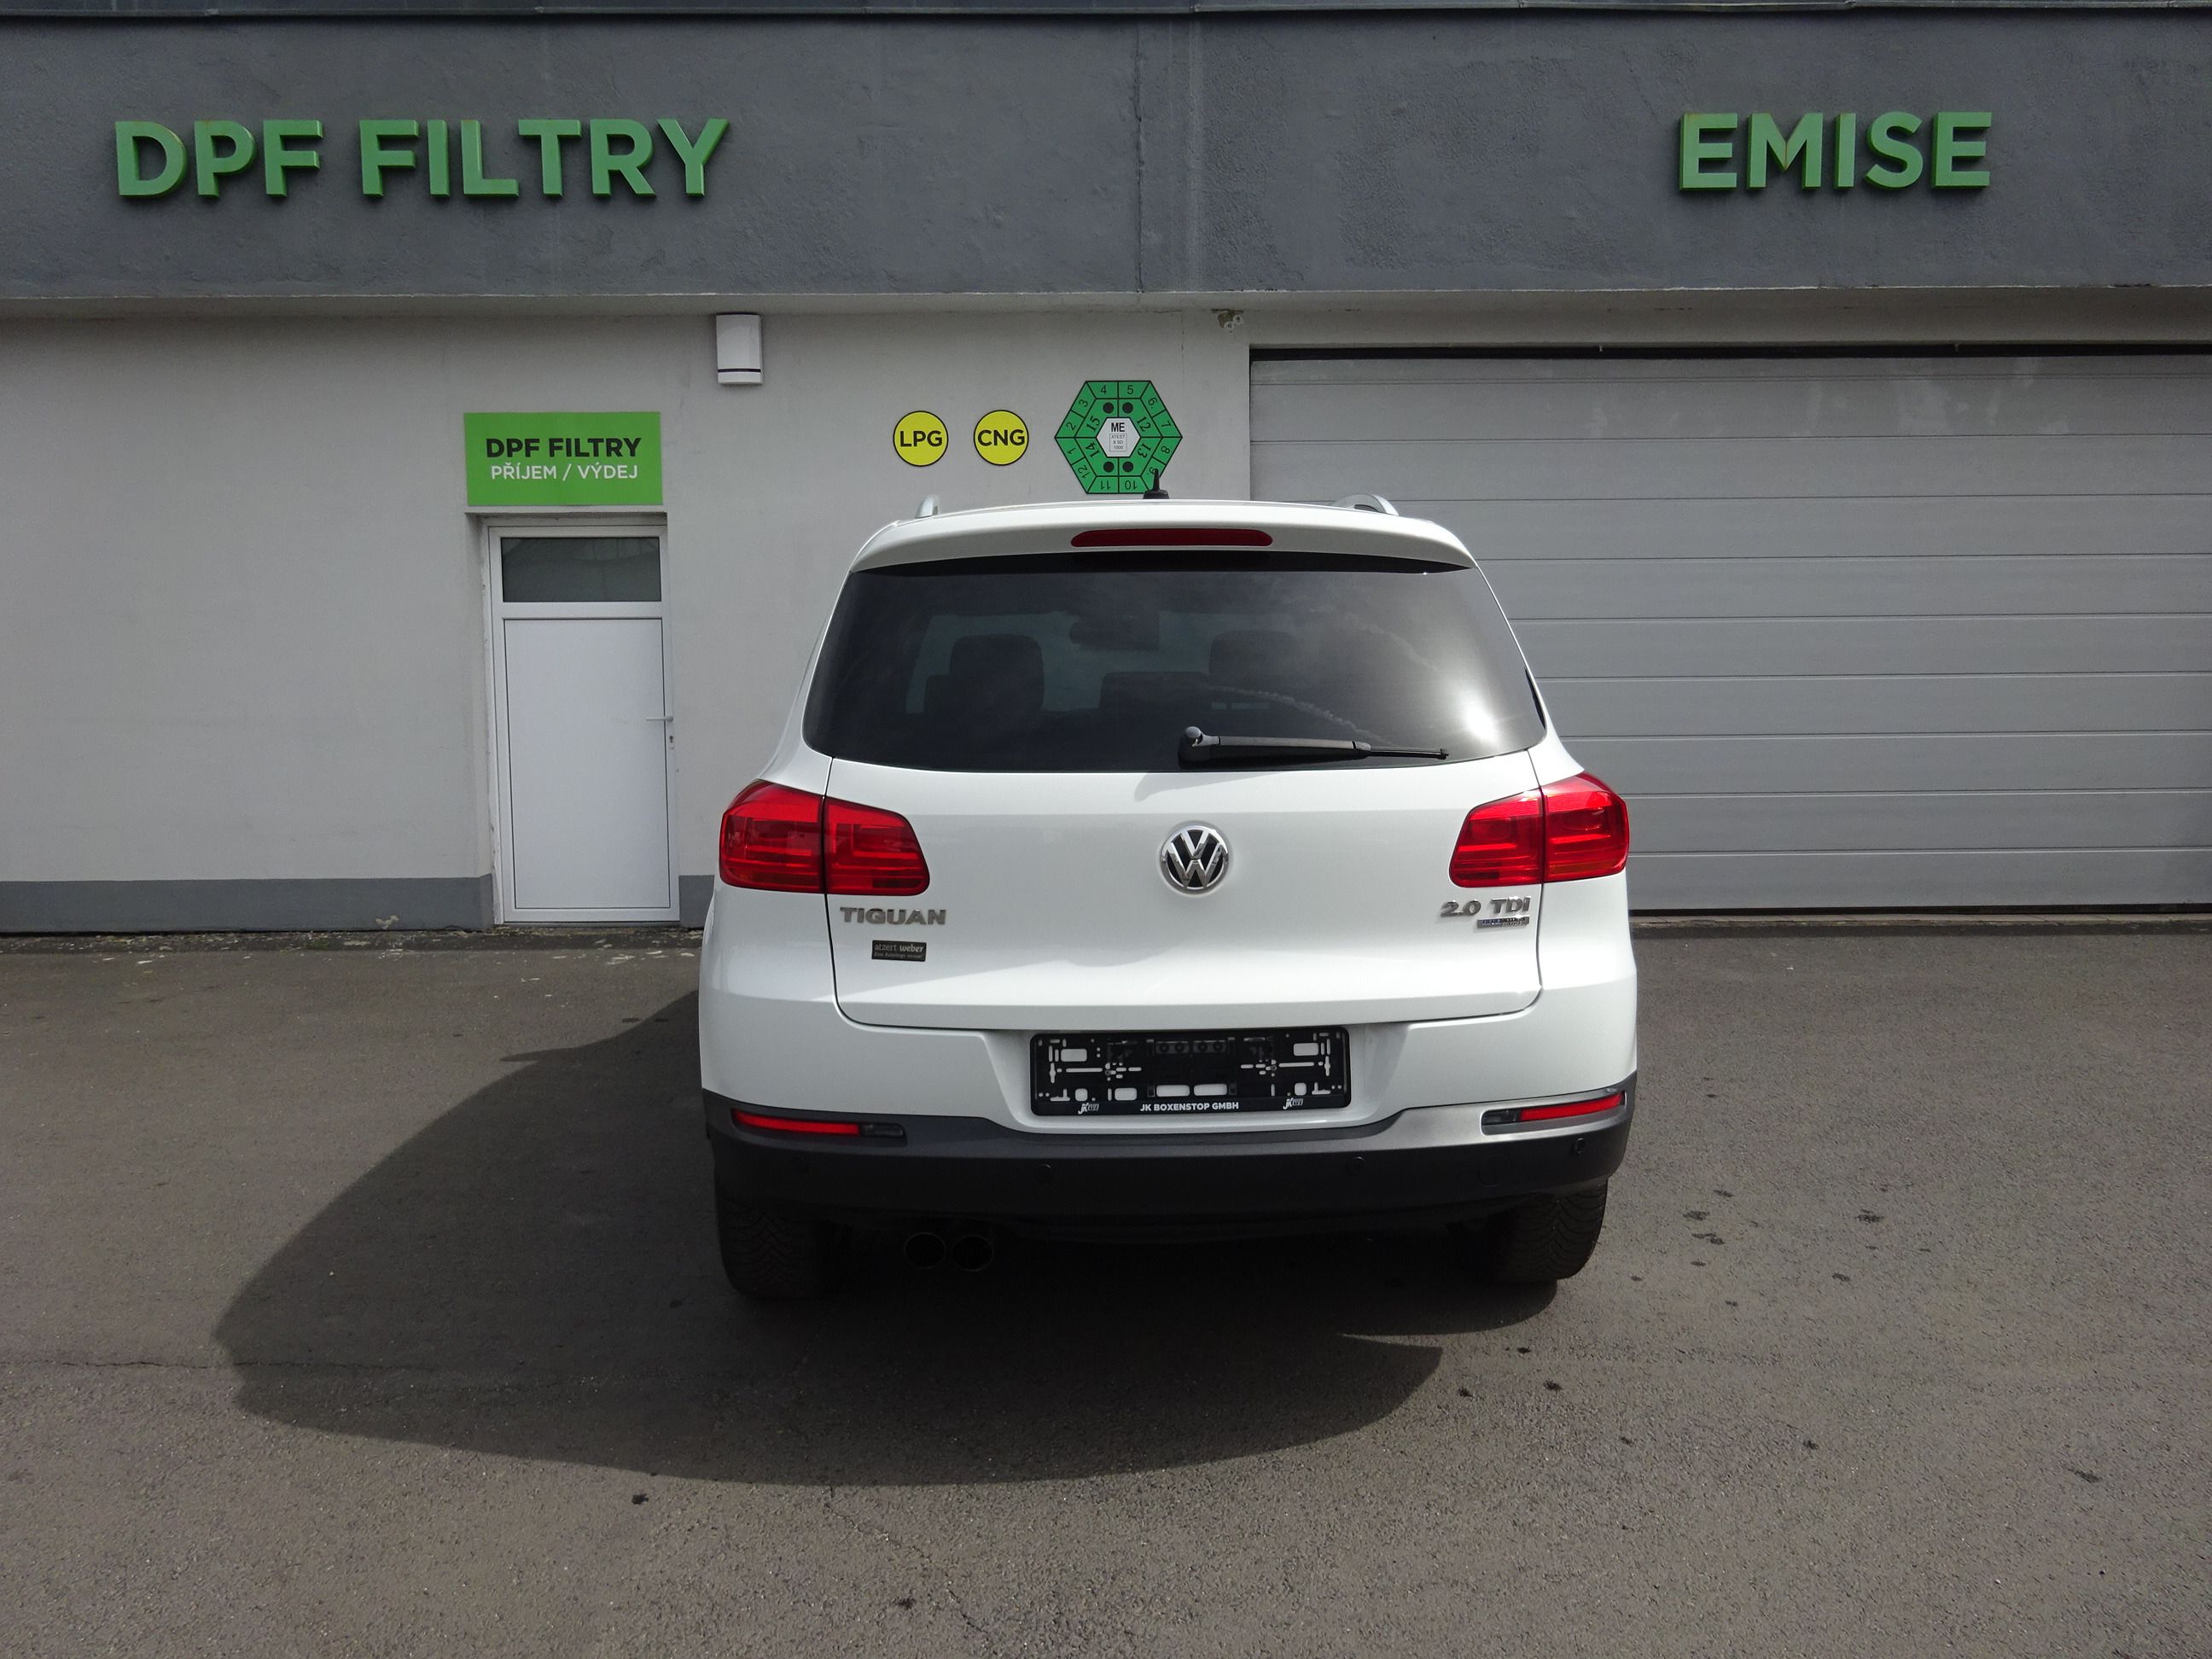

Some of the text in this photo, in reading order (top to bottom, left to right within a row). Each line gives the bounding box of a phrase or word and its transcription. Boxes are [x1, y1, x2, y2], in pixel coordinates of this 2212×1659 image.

[115, 118, 730, 197] DPF FILTRY
[1679, 111, 1993, 190] EMISE
[1100, 385, 1107, 394] 4
[1126, 385, 1134, 394] 5
[1078, 399, 1089, 408] 3
[1066, 422, 1076, 431] 2
[1086, 415, 1100, 431] 15
[1111, 422, 1126, 433] ME
[1137, 416, 1151, 432] 12
[899, 430, 943, 447] LPG
[977, 429, 1025, 446] CNG
[486, 437, 642, 458] DPF FILTRY
[1085, 441, 1100, 457] 14
[1138, 444, 1151, 458] 13
[1161, 445, 1170, 454] 8
[491, 462, 638, 481] PŘÍJEM / VÝDEJ
[1077, 464, 1091, 479] 12
[1100, 480, 1110, 490] 11
[1124, 480, 1138, 491] 10
[1163, 827, 1227, 891] VW
[1441, 896, 1532, 917] 2.0 TDI
[840, 906, 946, 925] TIGUAN
[899, 944, 924, 952] weber
[1140, 1102, 1239, 1112] JK BOXENSTOP GMBH
